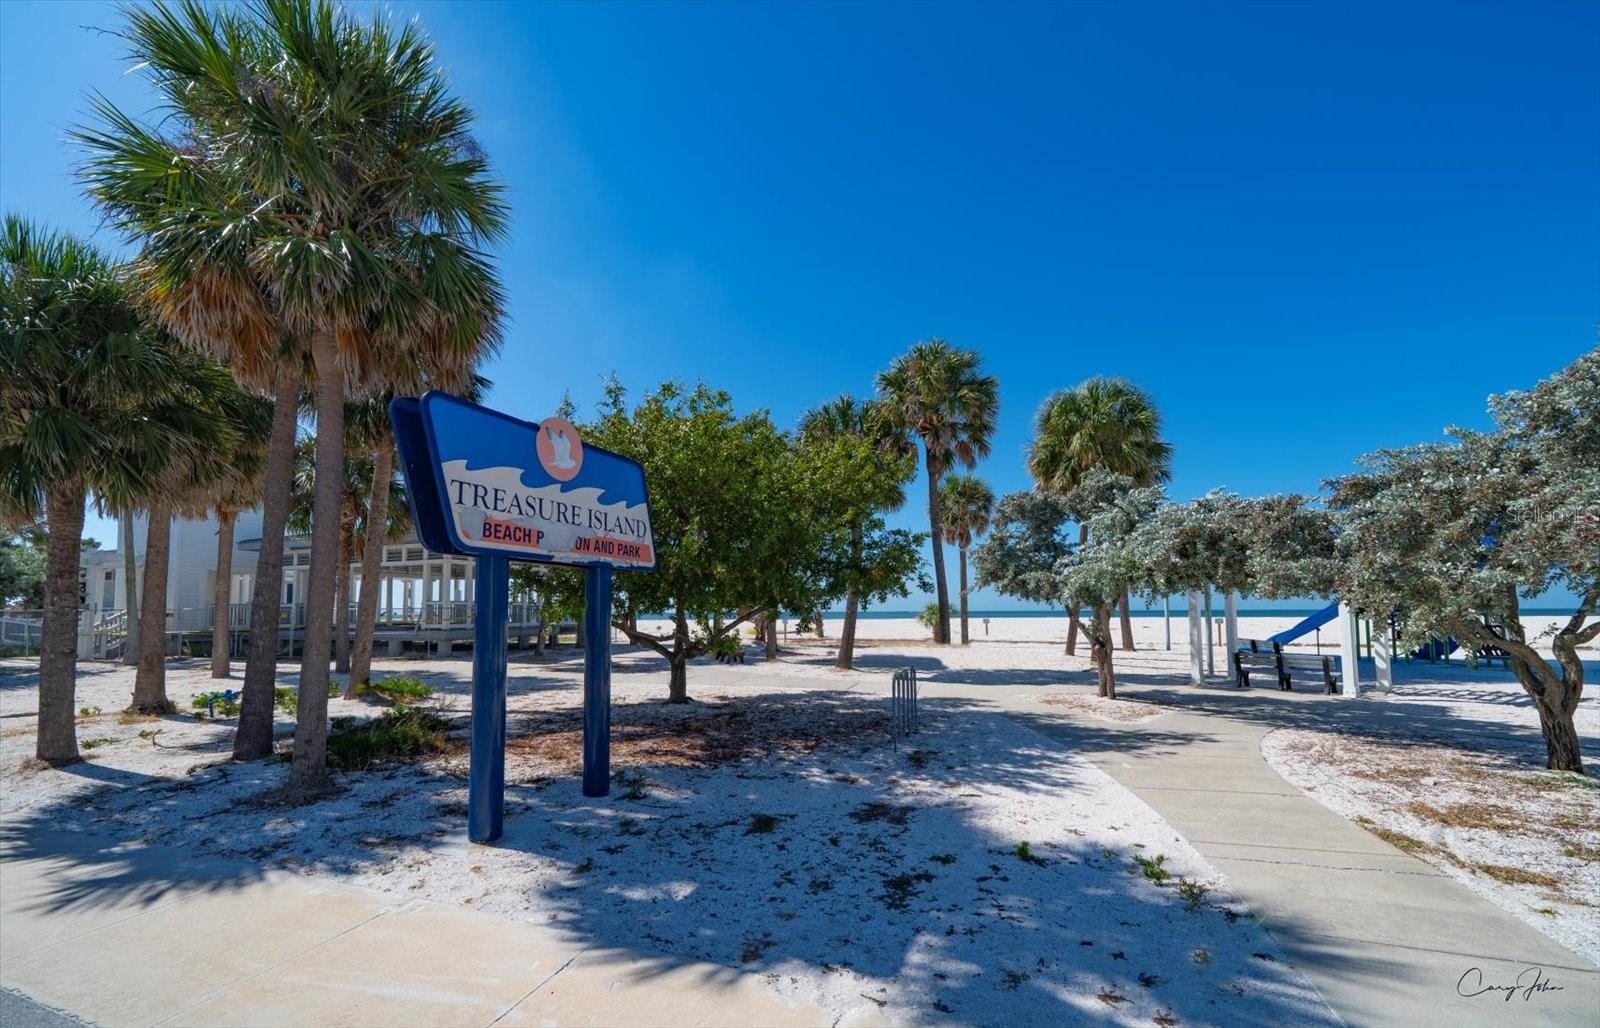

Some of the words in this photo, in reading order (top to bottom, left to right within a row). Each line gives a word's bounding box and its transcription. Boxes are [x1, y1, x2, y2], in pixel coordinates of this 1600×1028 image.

[451, 479, 582, 526] TREASURE
[587, 508, 647, 538] ISLAND
[483, 522, 532, 543] BEACH
[594, 540, 615, 555] AND
[617, 543, 641, 558] PARK
